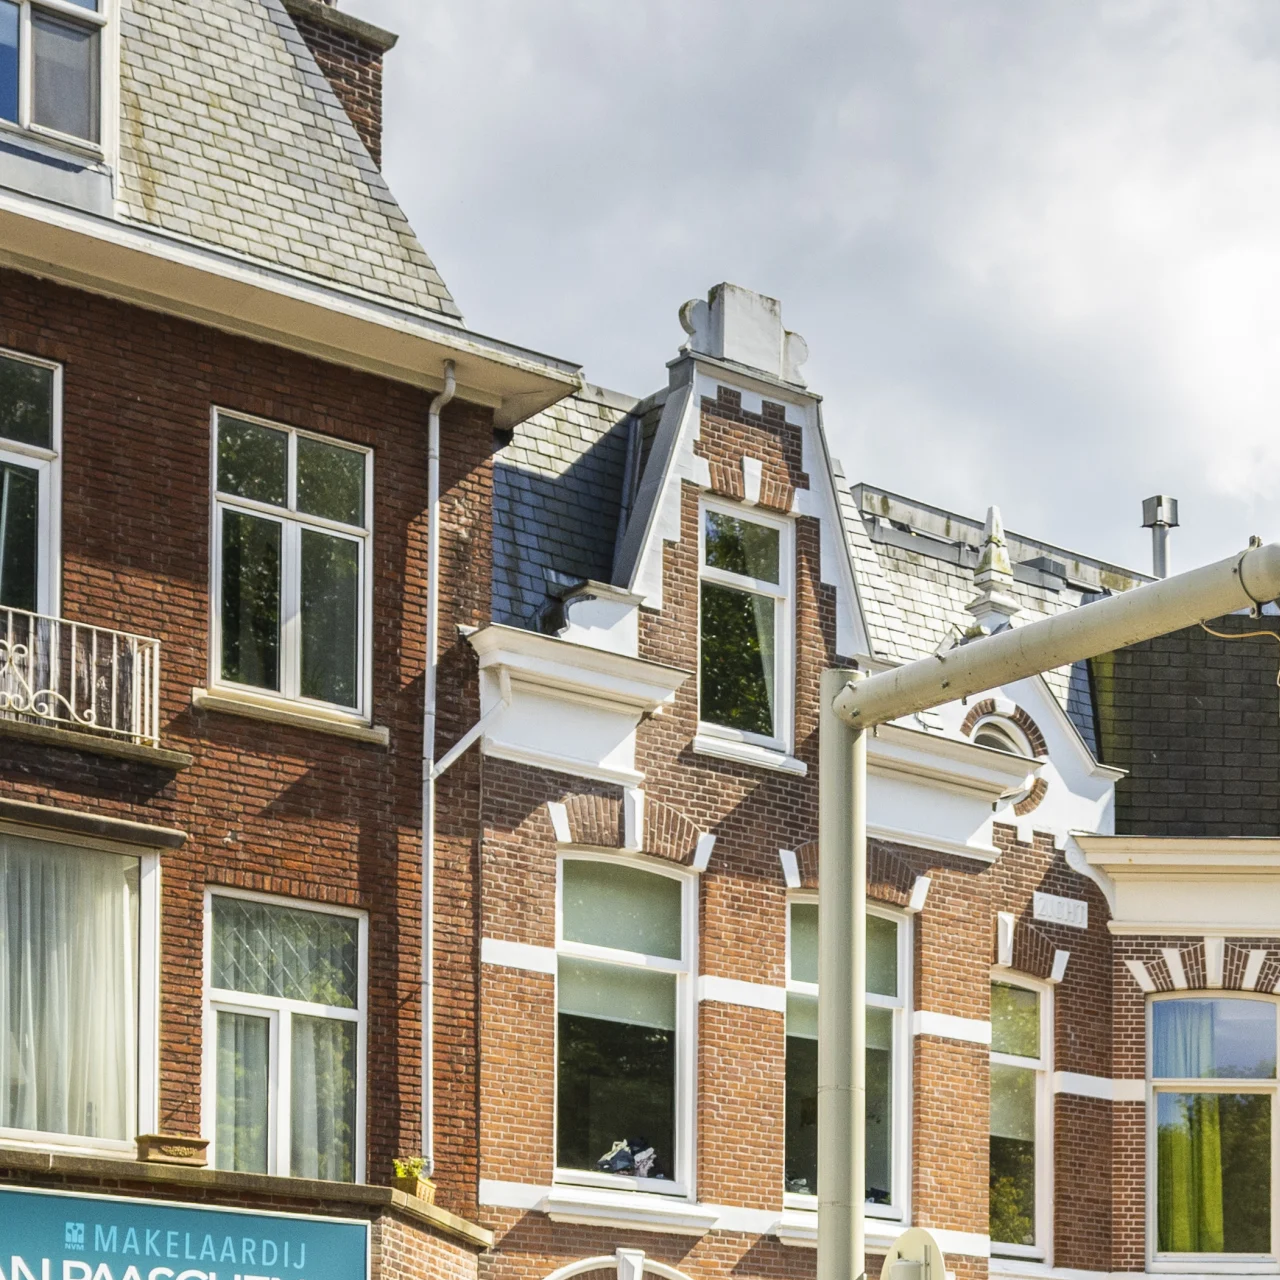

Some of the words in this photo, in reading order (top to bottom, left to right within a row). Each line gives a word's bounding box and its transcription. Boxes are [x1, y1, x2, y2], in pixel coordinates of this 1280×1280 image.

[1037, 896, 1085, 924] ZICHT
[65, 1242, 85, 1250] NVM
[94, 1223, 306, 1270] MAKELAARDIJ
